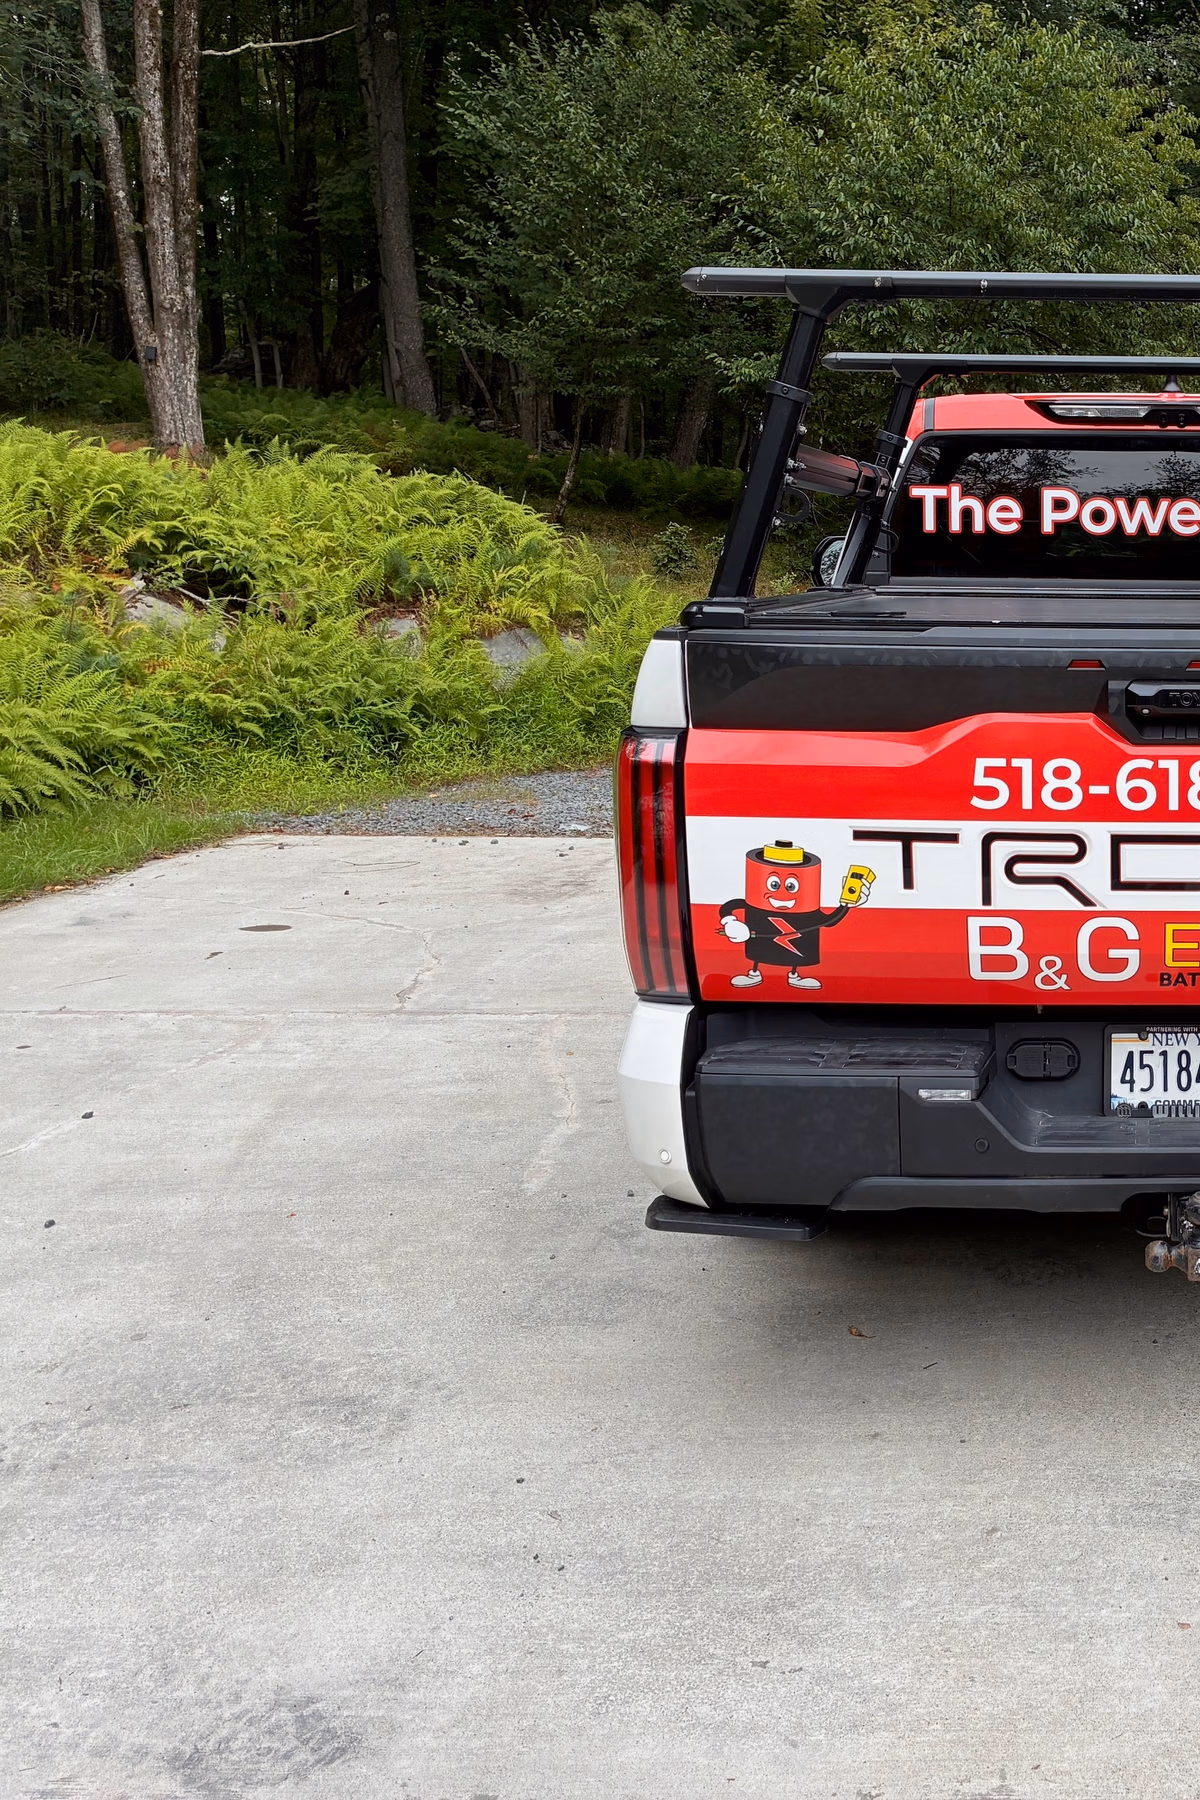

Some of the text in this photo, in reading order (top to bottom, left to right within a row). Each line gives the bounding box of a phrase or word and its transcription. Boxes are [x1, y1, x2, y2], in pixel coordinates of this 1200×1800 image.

[909, 484, 1023, 535] The
[966, 915, 1141, 990] B&G
[1151, 1032, 1190, 1047] NEW
